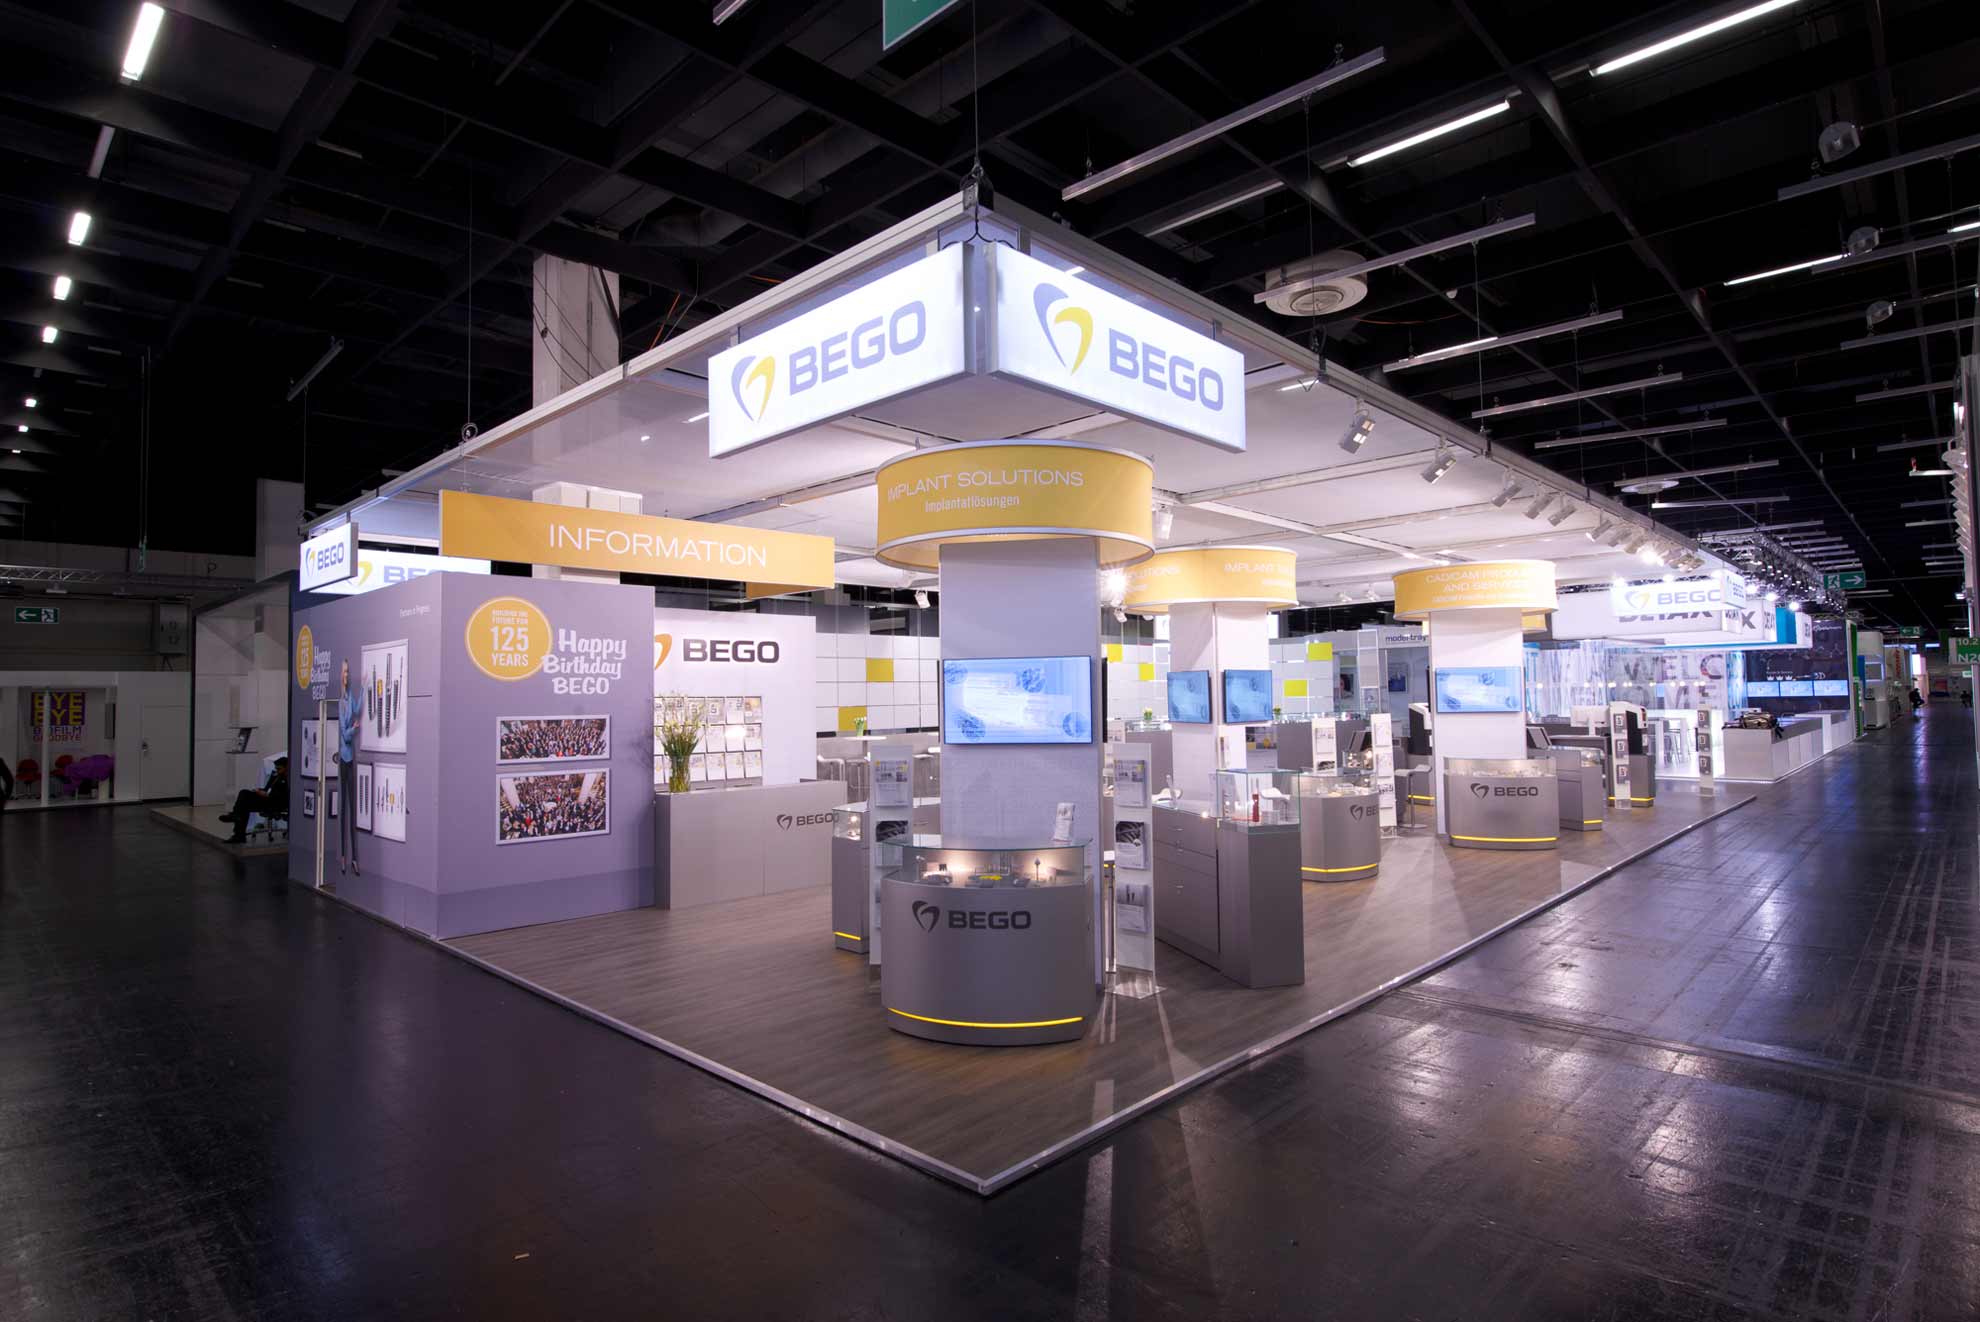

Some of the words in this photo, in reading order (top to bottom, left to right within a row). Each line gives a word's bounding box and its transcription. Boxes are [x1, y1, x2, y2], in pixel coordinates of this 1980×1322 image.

[789, 300, 926, 396] BEGO
[1108, 327, 1224, 412] BEGO
[887, 471, 952, 502] IMPLANT
[957, 469, 1084, 489] SOLUTIONS
[925, 493, 1020, 513] Implantatlösungen
[317, 541, 345, 571] BEGO
[549, 523, 767, 568] INFORMATION
[490, 626, 529, 652] 125
[558, 628, 627, 661] Happy
[683, 638, 780, 664] BEGO
[491, 653, 529, 667] YEARS
[541, 653, 622, 680] Birthday
[552, 676, 610, 695] BEGO
[1494, 786, 1539, 797] BEGO
[796, 812, 834, 826] BEGO
[947, 910, 1032, 930] BEGO
